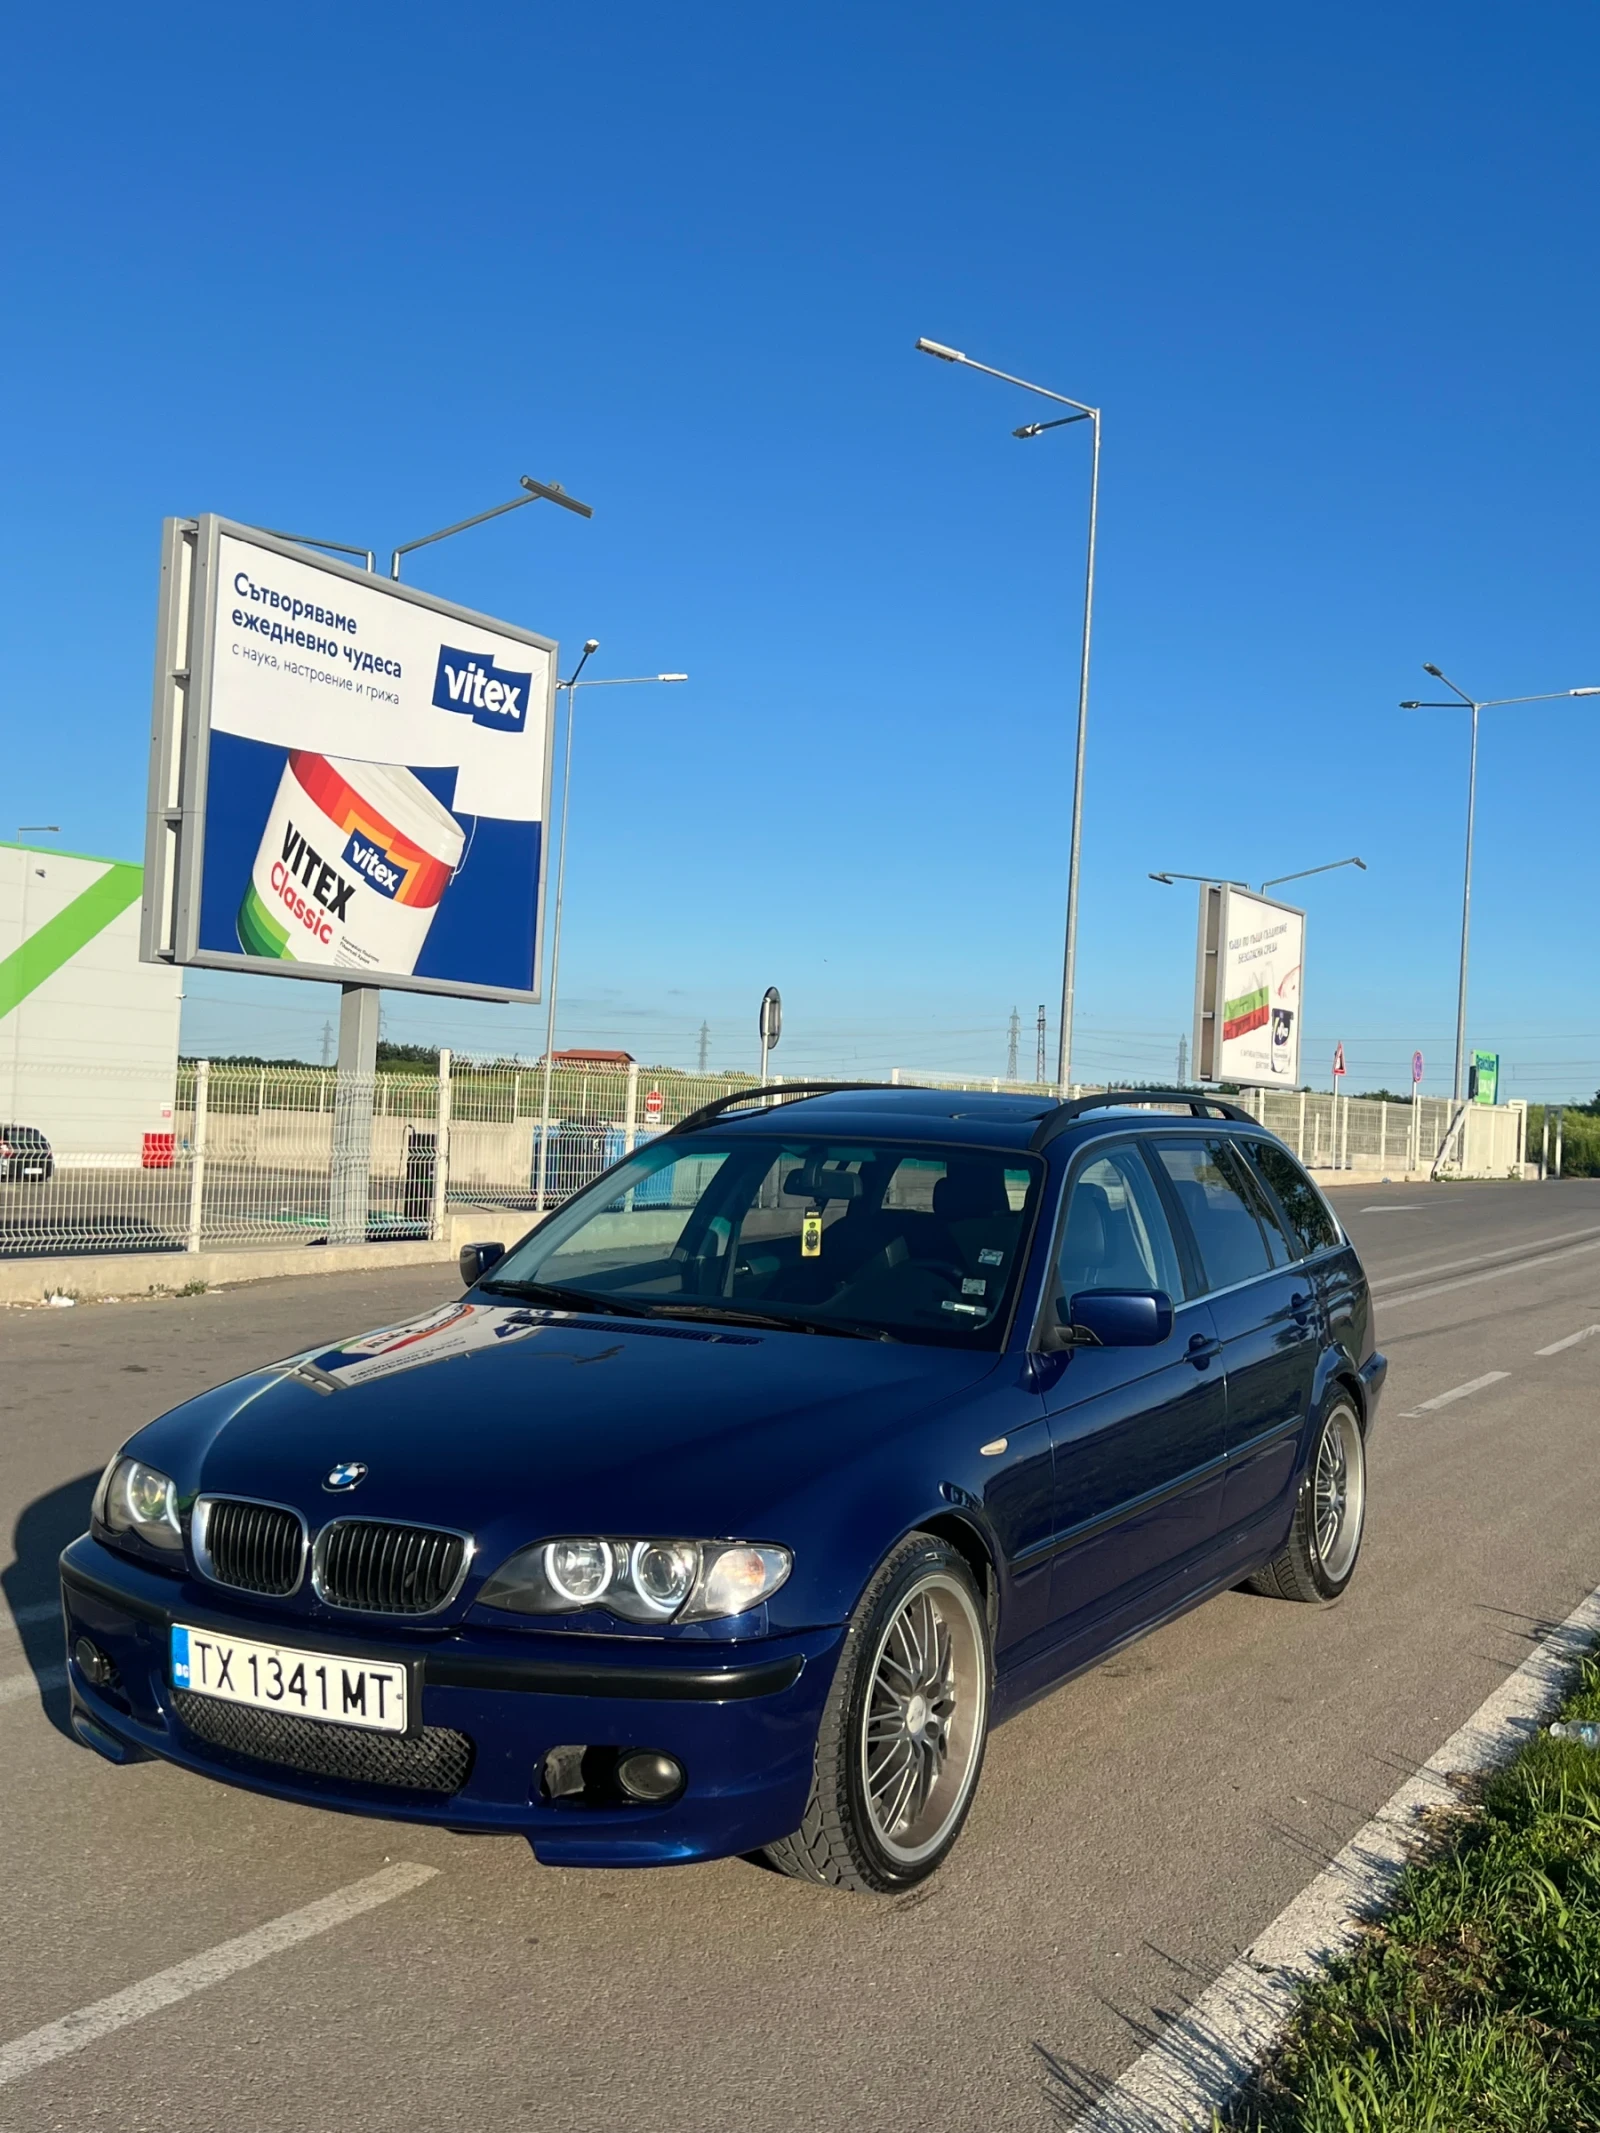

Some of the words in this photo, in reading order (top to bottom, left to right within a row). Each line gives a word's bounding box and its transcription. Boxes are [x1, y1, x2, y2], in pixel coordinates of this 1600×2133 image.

[234, 572, 357, 635] Сътворяваме
[232, 609, 338, 658] ежедневно
[343, 645, 402, 679] чудеса
[232, 643, 240, 655] с
[243, 646, 281, 671] наука,
[284, 660, 353, 691] настроение
[356, 683, 363, 694] и
[366, 685, 400, 705] грижа
[444, 661, 521, 719] vitex
[281, 819, 357, 924] VITEX
[352, 840, 399, 893] vitex
[271, 861, 333, 945] Classic
[175, 1662, 190, 1678] BG
[194, 1639, 236, 1692] TX
[247, 1653, 328, 1711] 1341
[341, 1668, 393, 1719] MT
